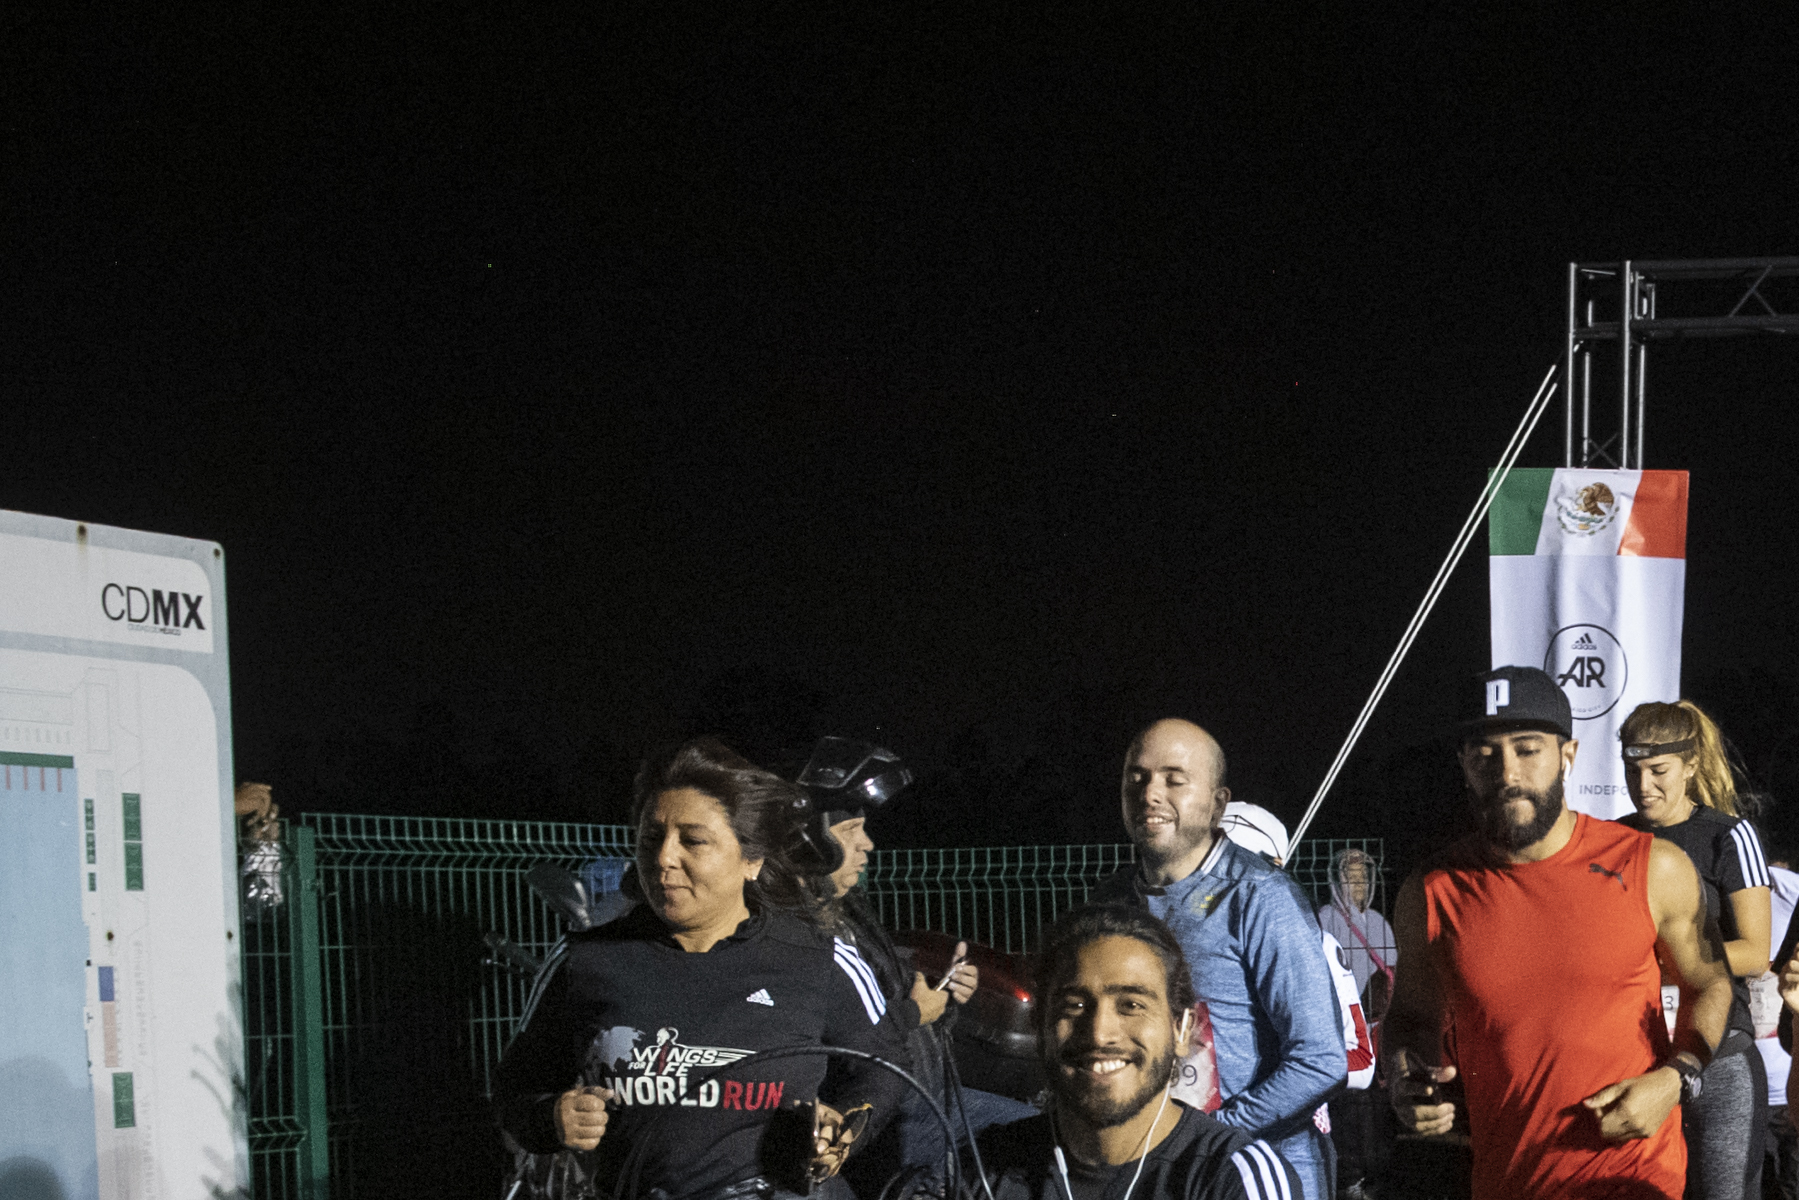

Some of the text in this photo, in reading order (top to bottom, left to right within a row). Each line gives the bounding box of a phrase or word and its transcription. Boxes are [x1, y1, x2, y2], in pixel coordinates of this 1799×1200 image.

[102, 583, 206, 630] CDMX
[1557, 656, 1606, 688] AR
[633, 1048, 719, 1064] WINGS
[605, 1076, 785, 1111] WORLD RUN
